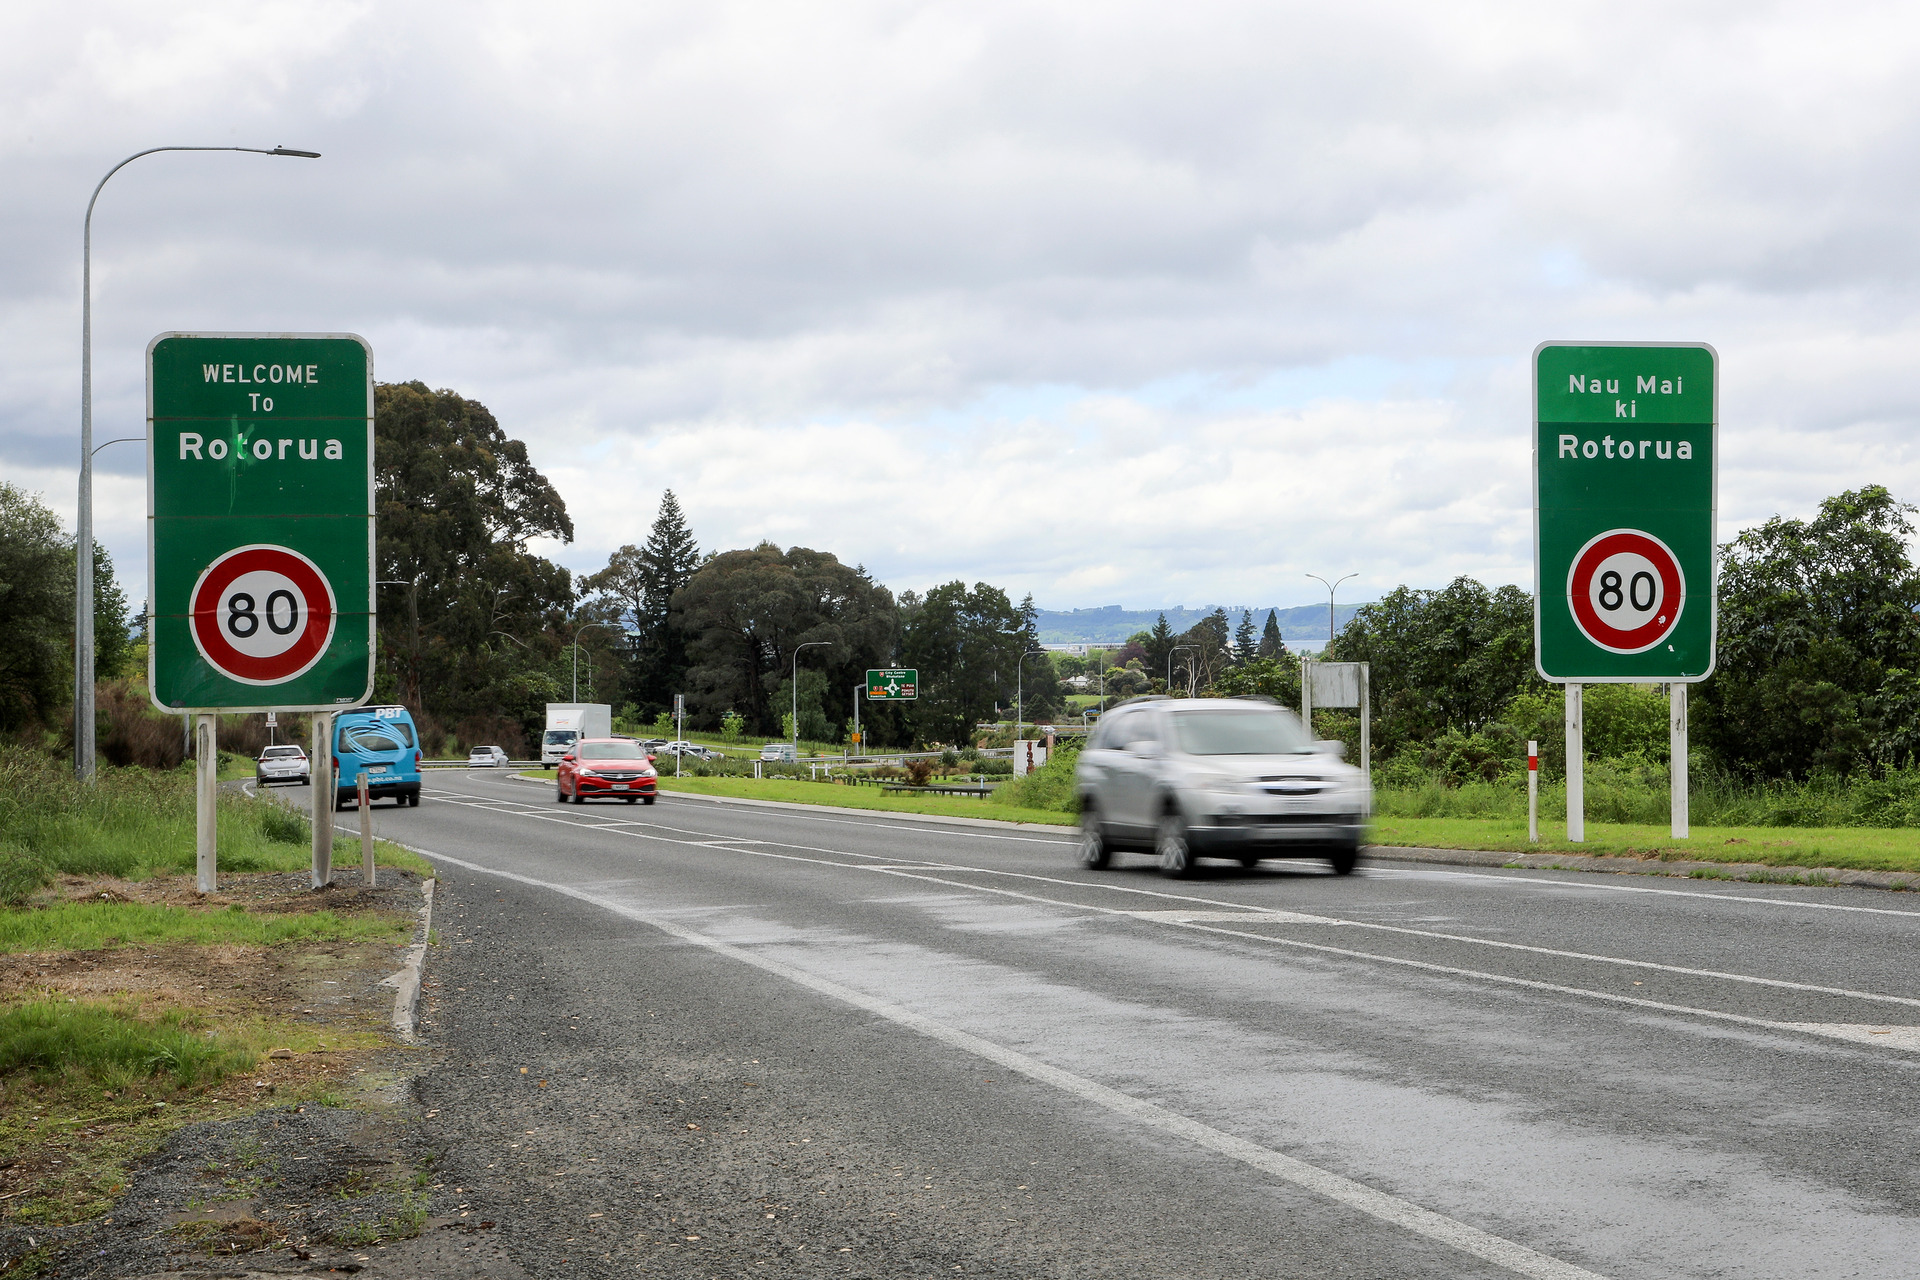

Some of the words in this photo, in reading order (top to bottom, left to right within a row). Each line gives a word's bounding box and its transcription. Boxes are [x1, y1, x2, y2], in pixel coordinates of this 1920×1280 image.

[203, 364, 318, 383] WELCOME
[1569, 374, 1619, 394] Nau
[1636, 375, 1682, 395] Mai
[248, 393, 274, 412] To
[1615, 399, 1636, 418] ki
[179, 432, 343, 460] Rotorua
[1558, 434, 1692, 460] Rotorua
[1599, 570, 1656, 611] 80
[227, 589, 299, 638] 80
[375, 708, 404, 719] PBT
